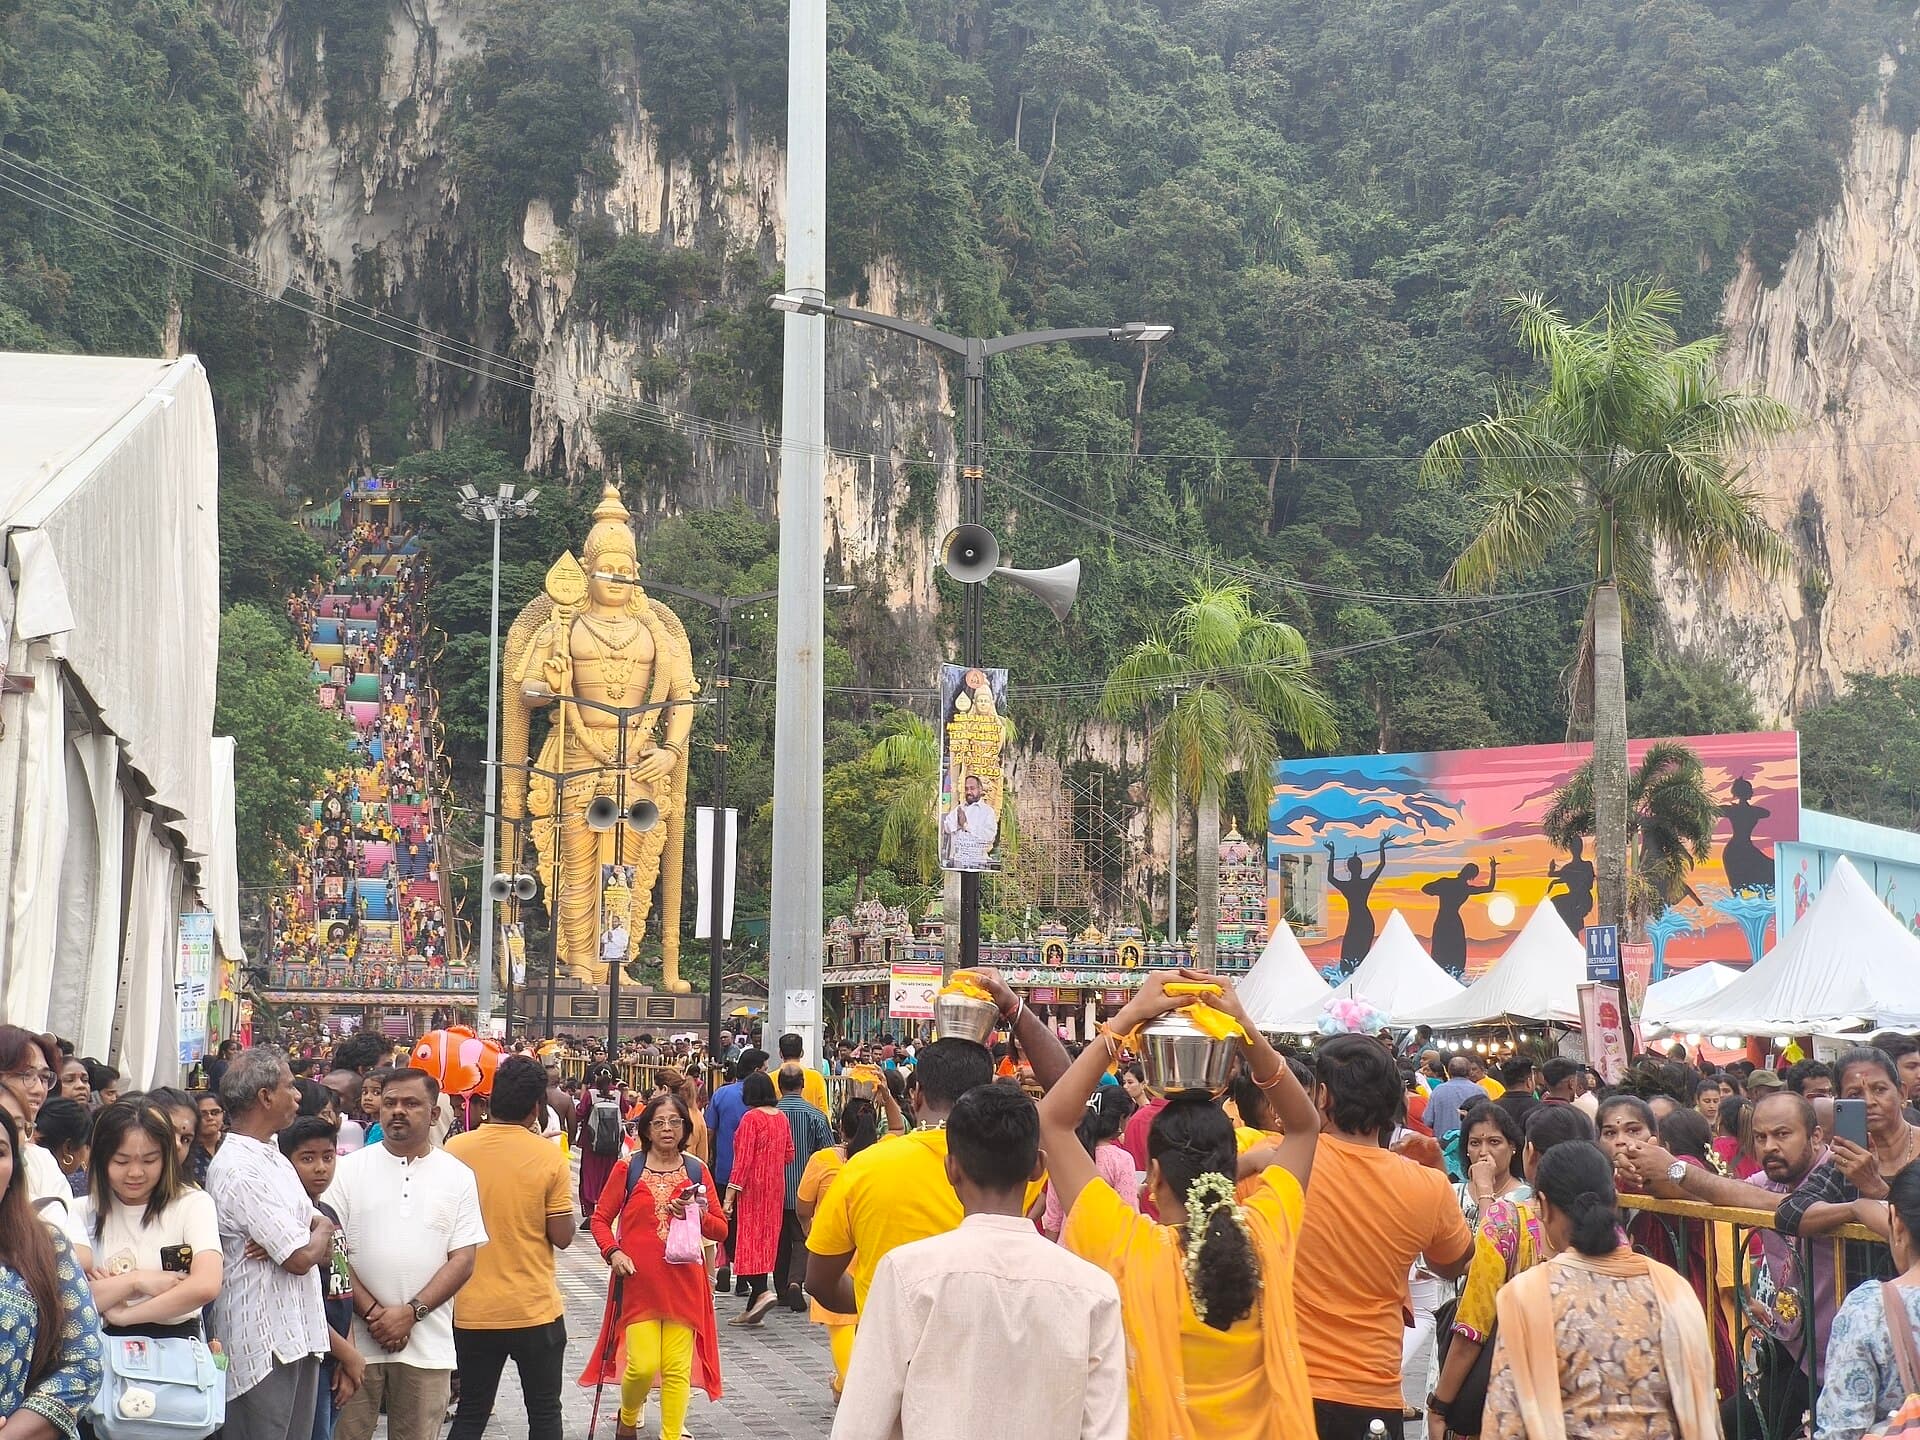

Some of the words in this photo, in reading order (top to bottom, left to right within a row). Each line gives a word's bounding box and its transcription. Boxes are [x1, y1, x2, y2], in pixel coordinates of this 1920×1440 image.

[953, 714, 996, 722] SELAMAT
[946, 722, 1002, 733] MENYAMBUT
[949, 732, 1000, 742] THAIPUSAM
[974, 767, 1000, 776] 2025
[1587, 956, 1616, 964] RESTROOMS
